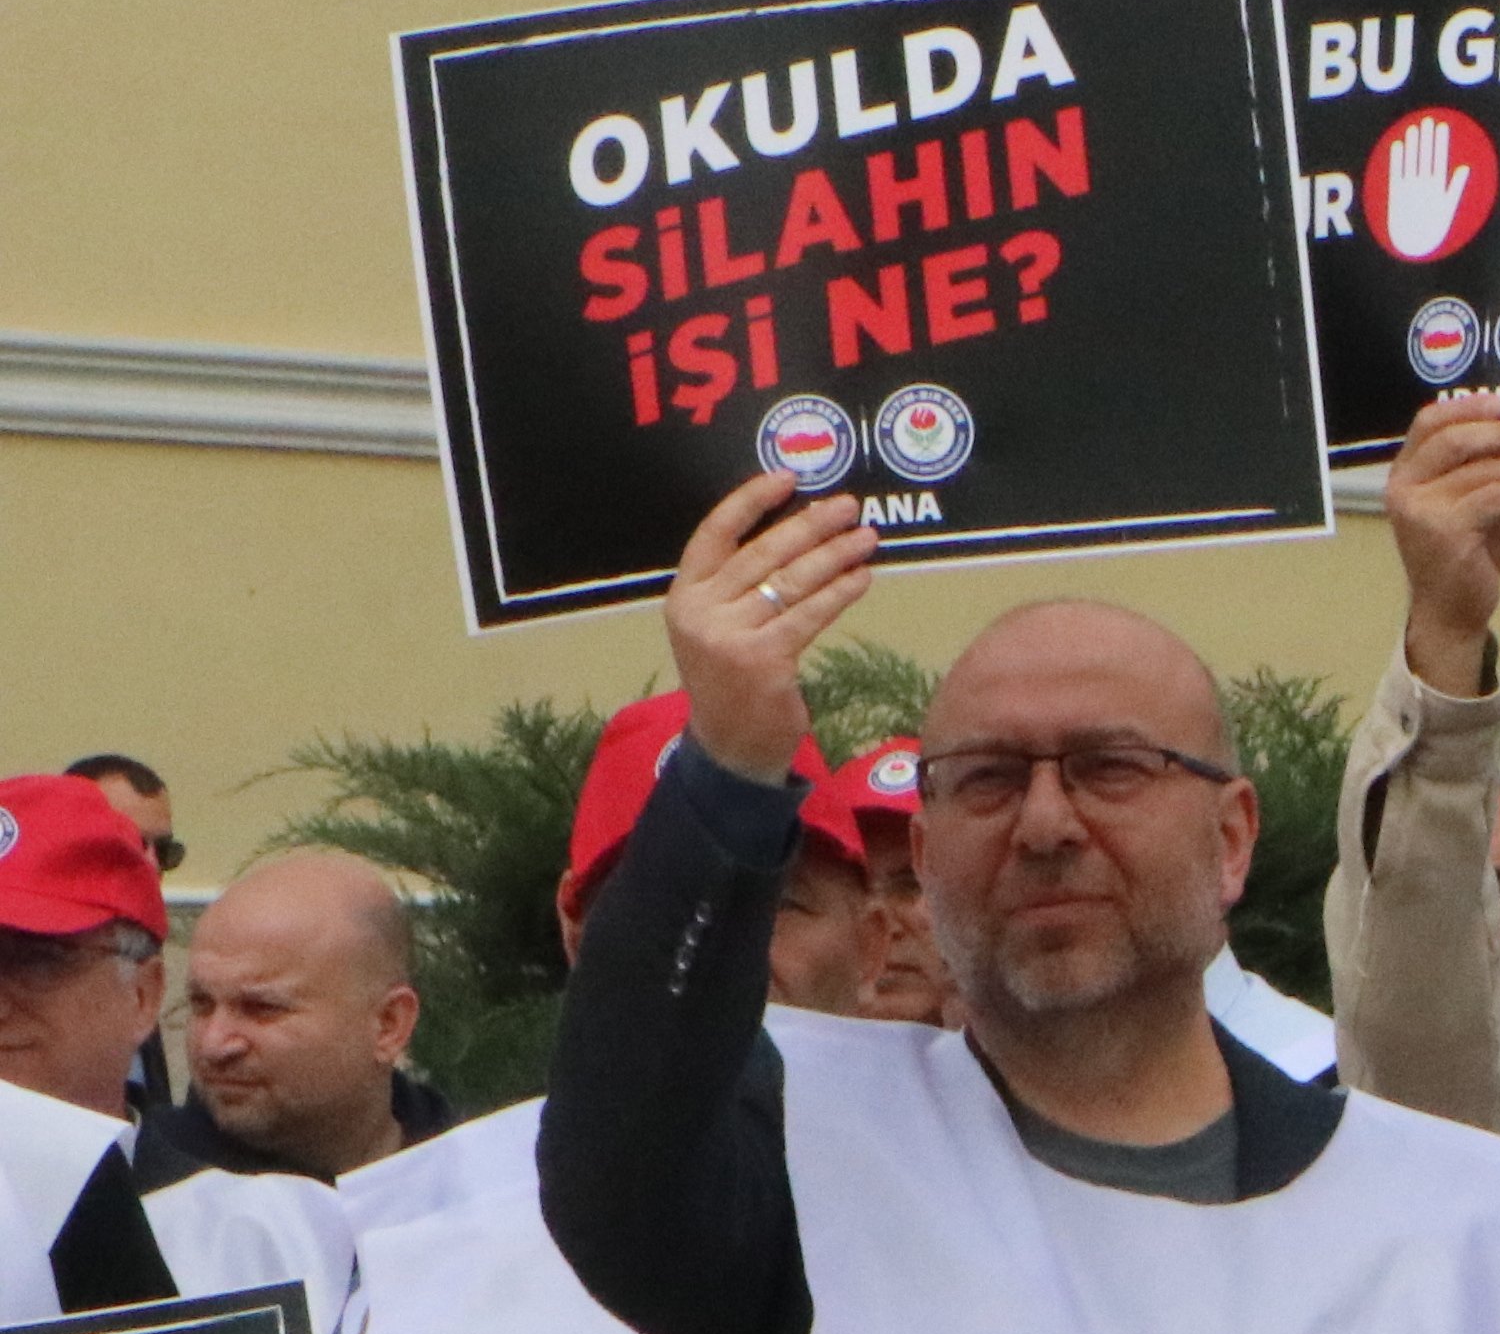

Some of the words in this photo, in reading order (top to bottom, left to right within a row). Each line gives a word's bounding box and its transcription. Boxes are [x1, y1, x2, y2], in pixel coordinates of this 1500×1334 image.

[569, 2, 1076, 209] OKULDA
[1308, 14, 1414, 100] BU
[578, 104, 1092, 324] SİLAHIN
[626, 294, 779, 426] İŞİ
[828, 229, 1064, 369] NE?
